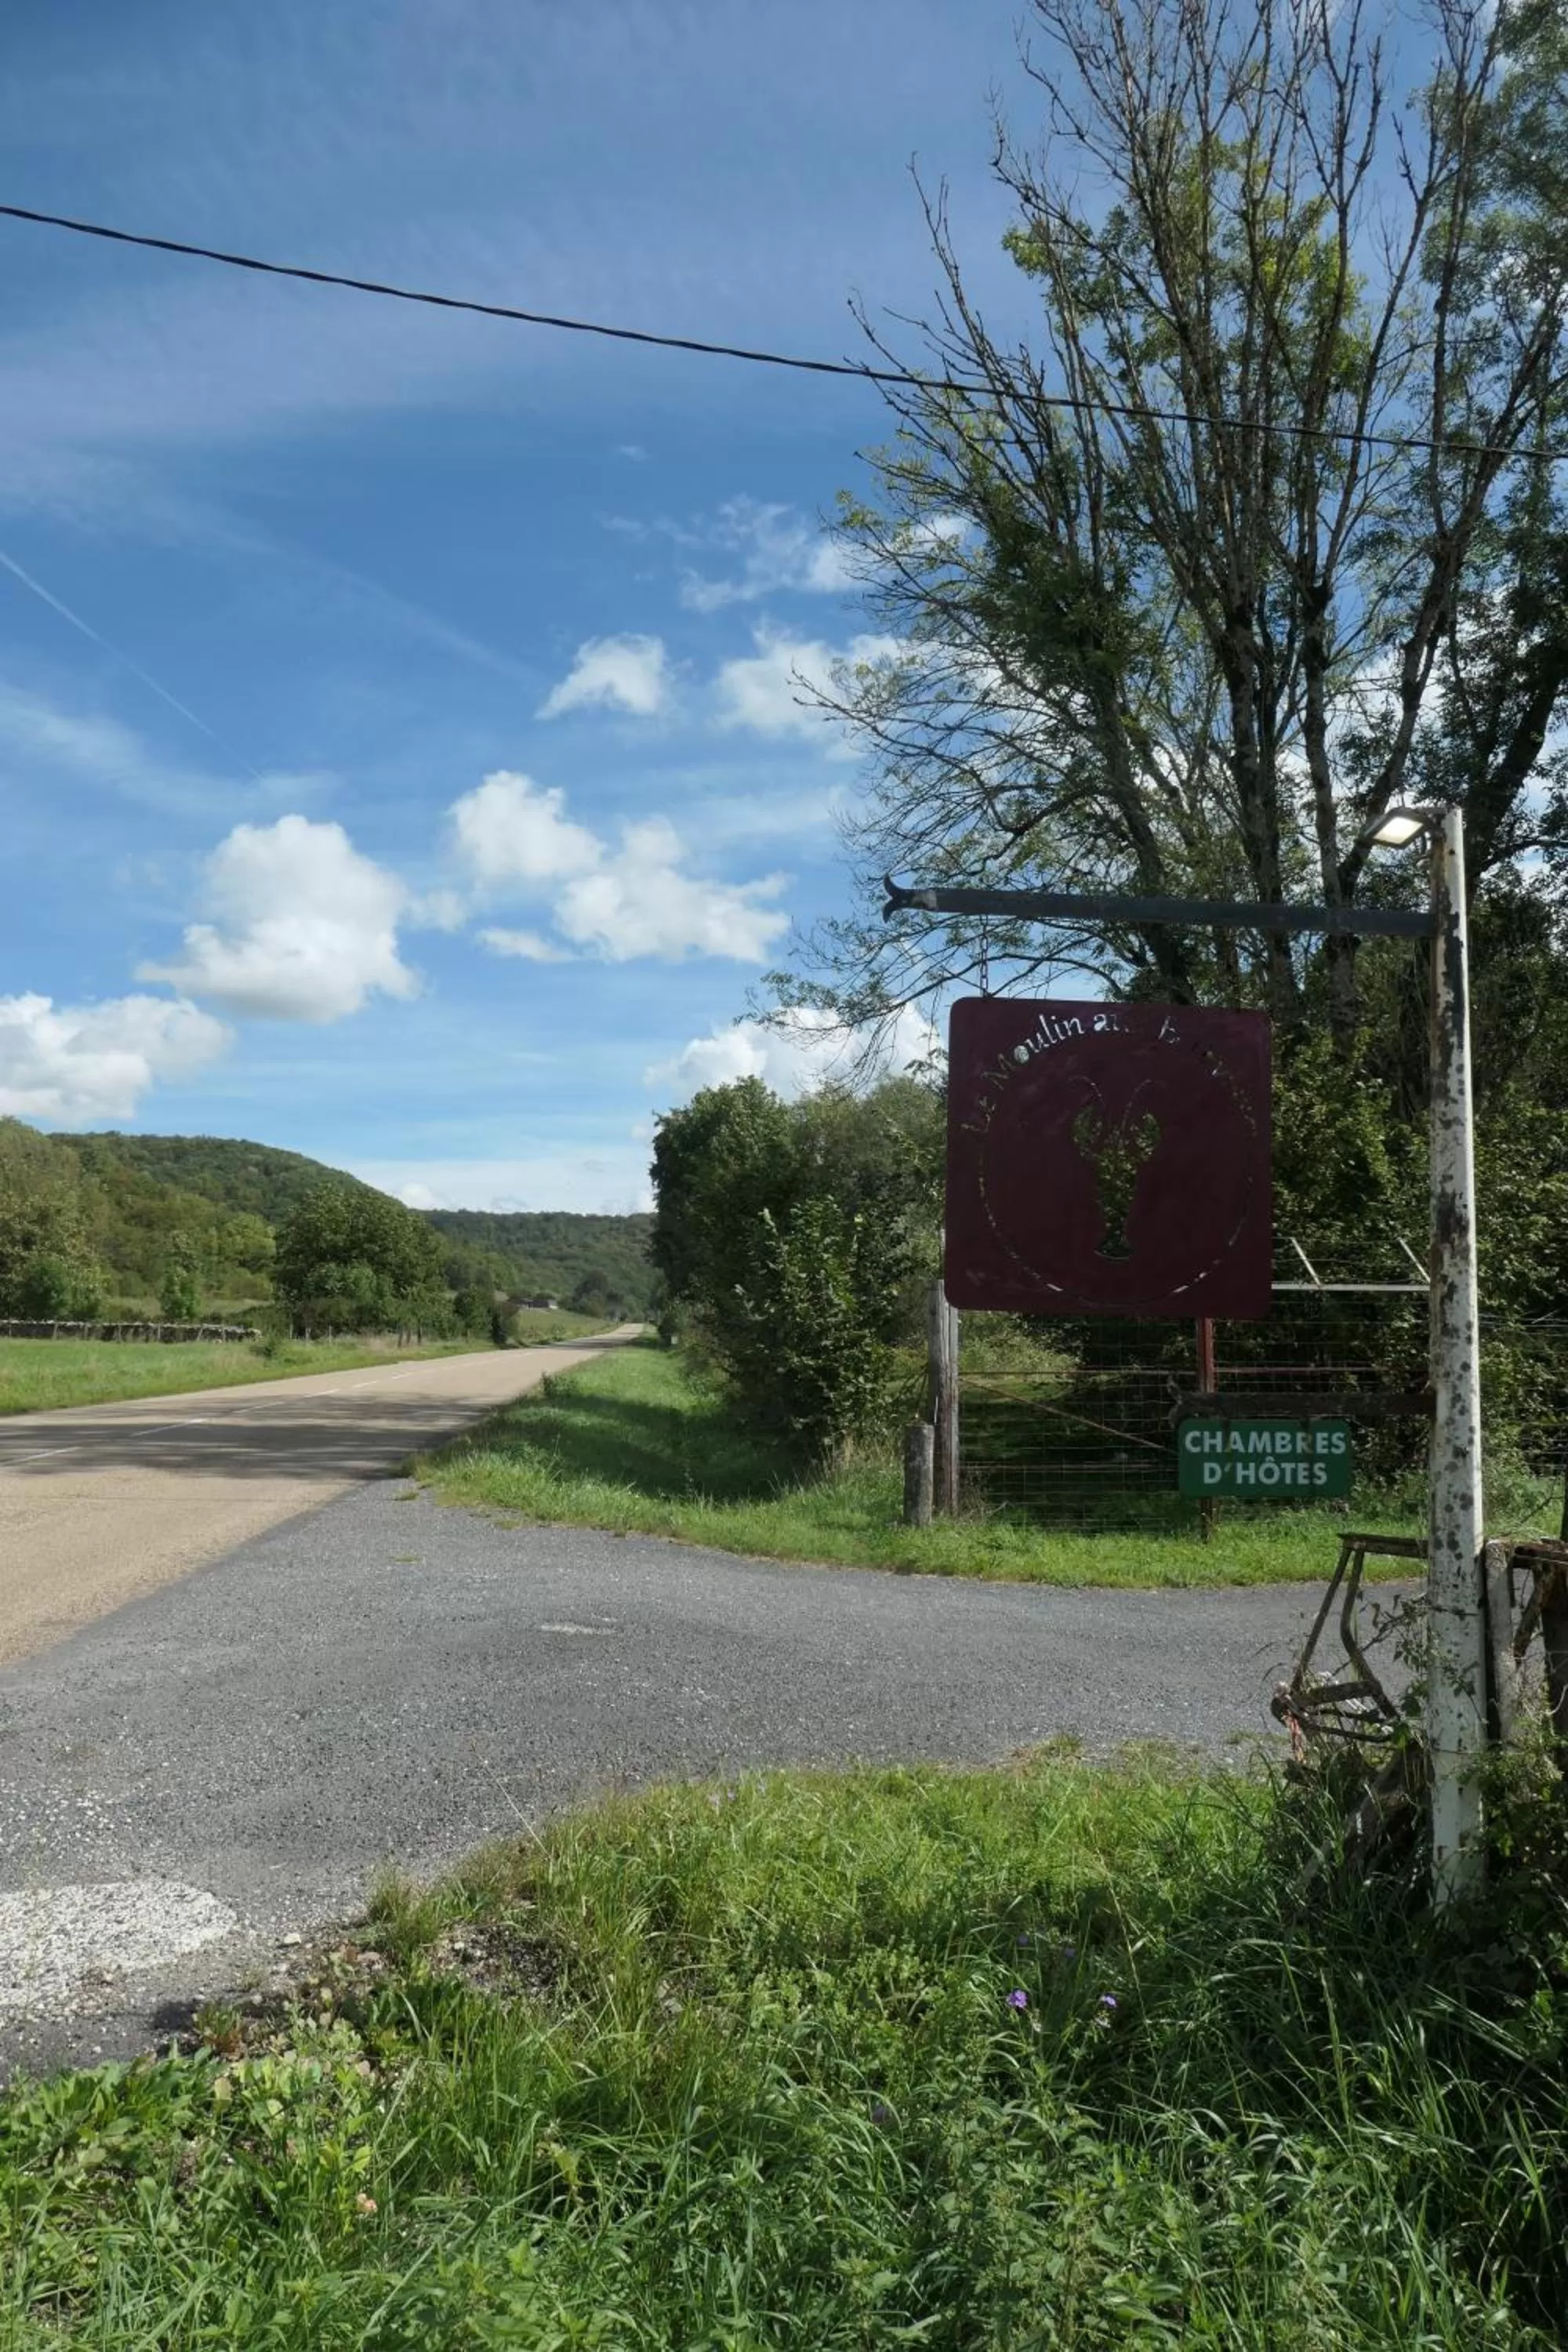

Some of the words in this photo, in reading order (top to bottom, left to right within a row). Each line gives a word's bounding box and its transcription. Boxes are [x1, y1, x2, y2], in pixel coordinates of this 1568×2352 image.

[979, 1014, 1085, 1090] Moulin
[1185, 1430, 1346, 1454] CHAMBRES
[1203, 1456, 1327, 1485] D'HÔTES
